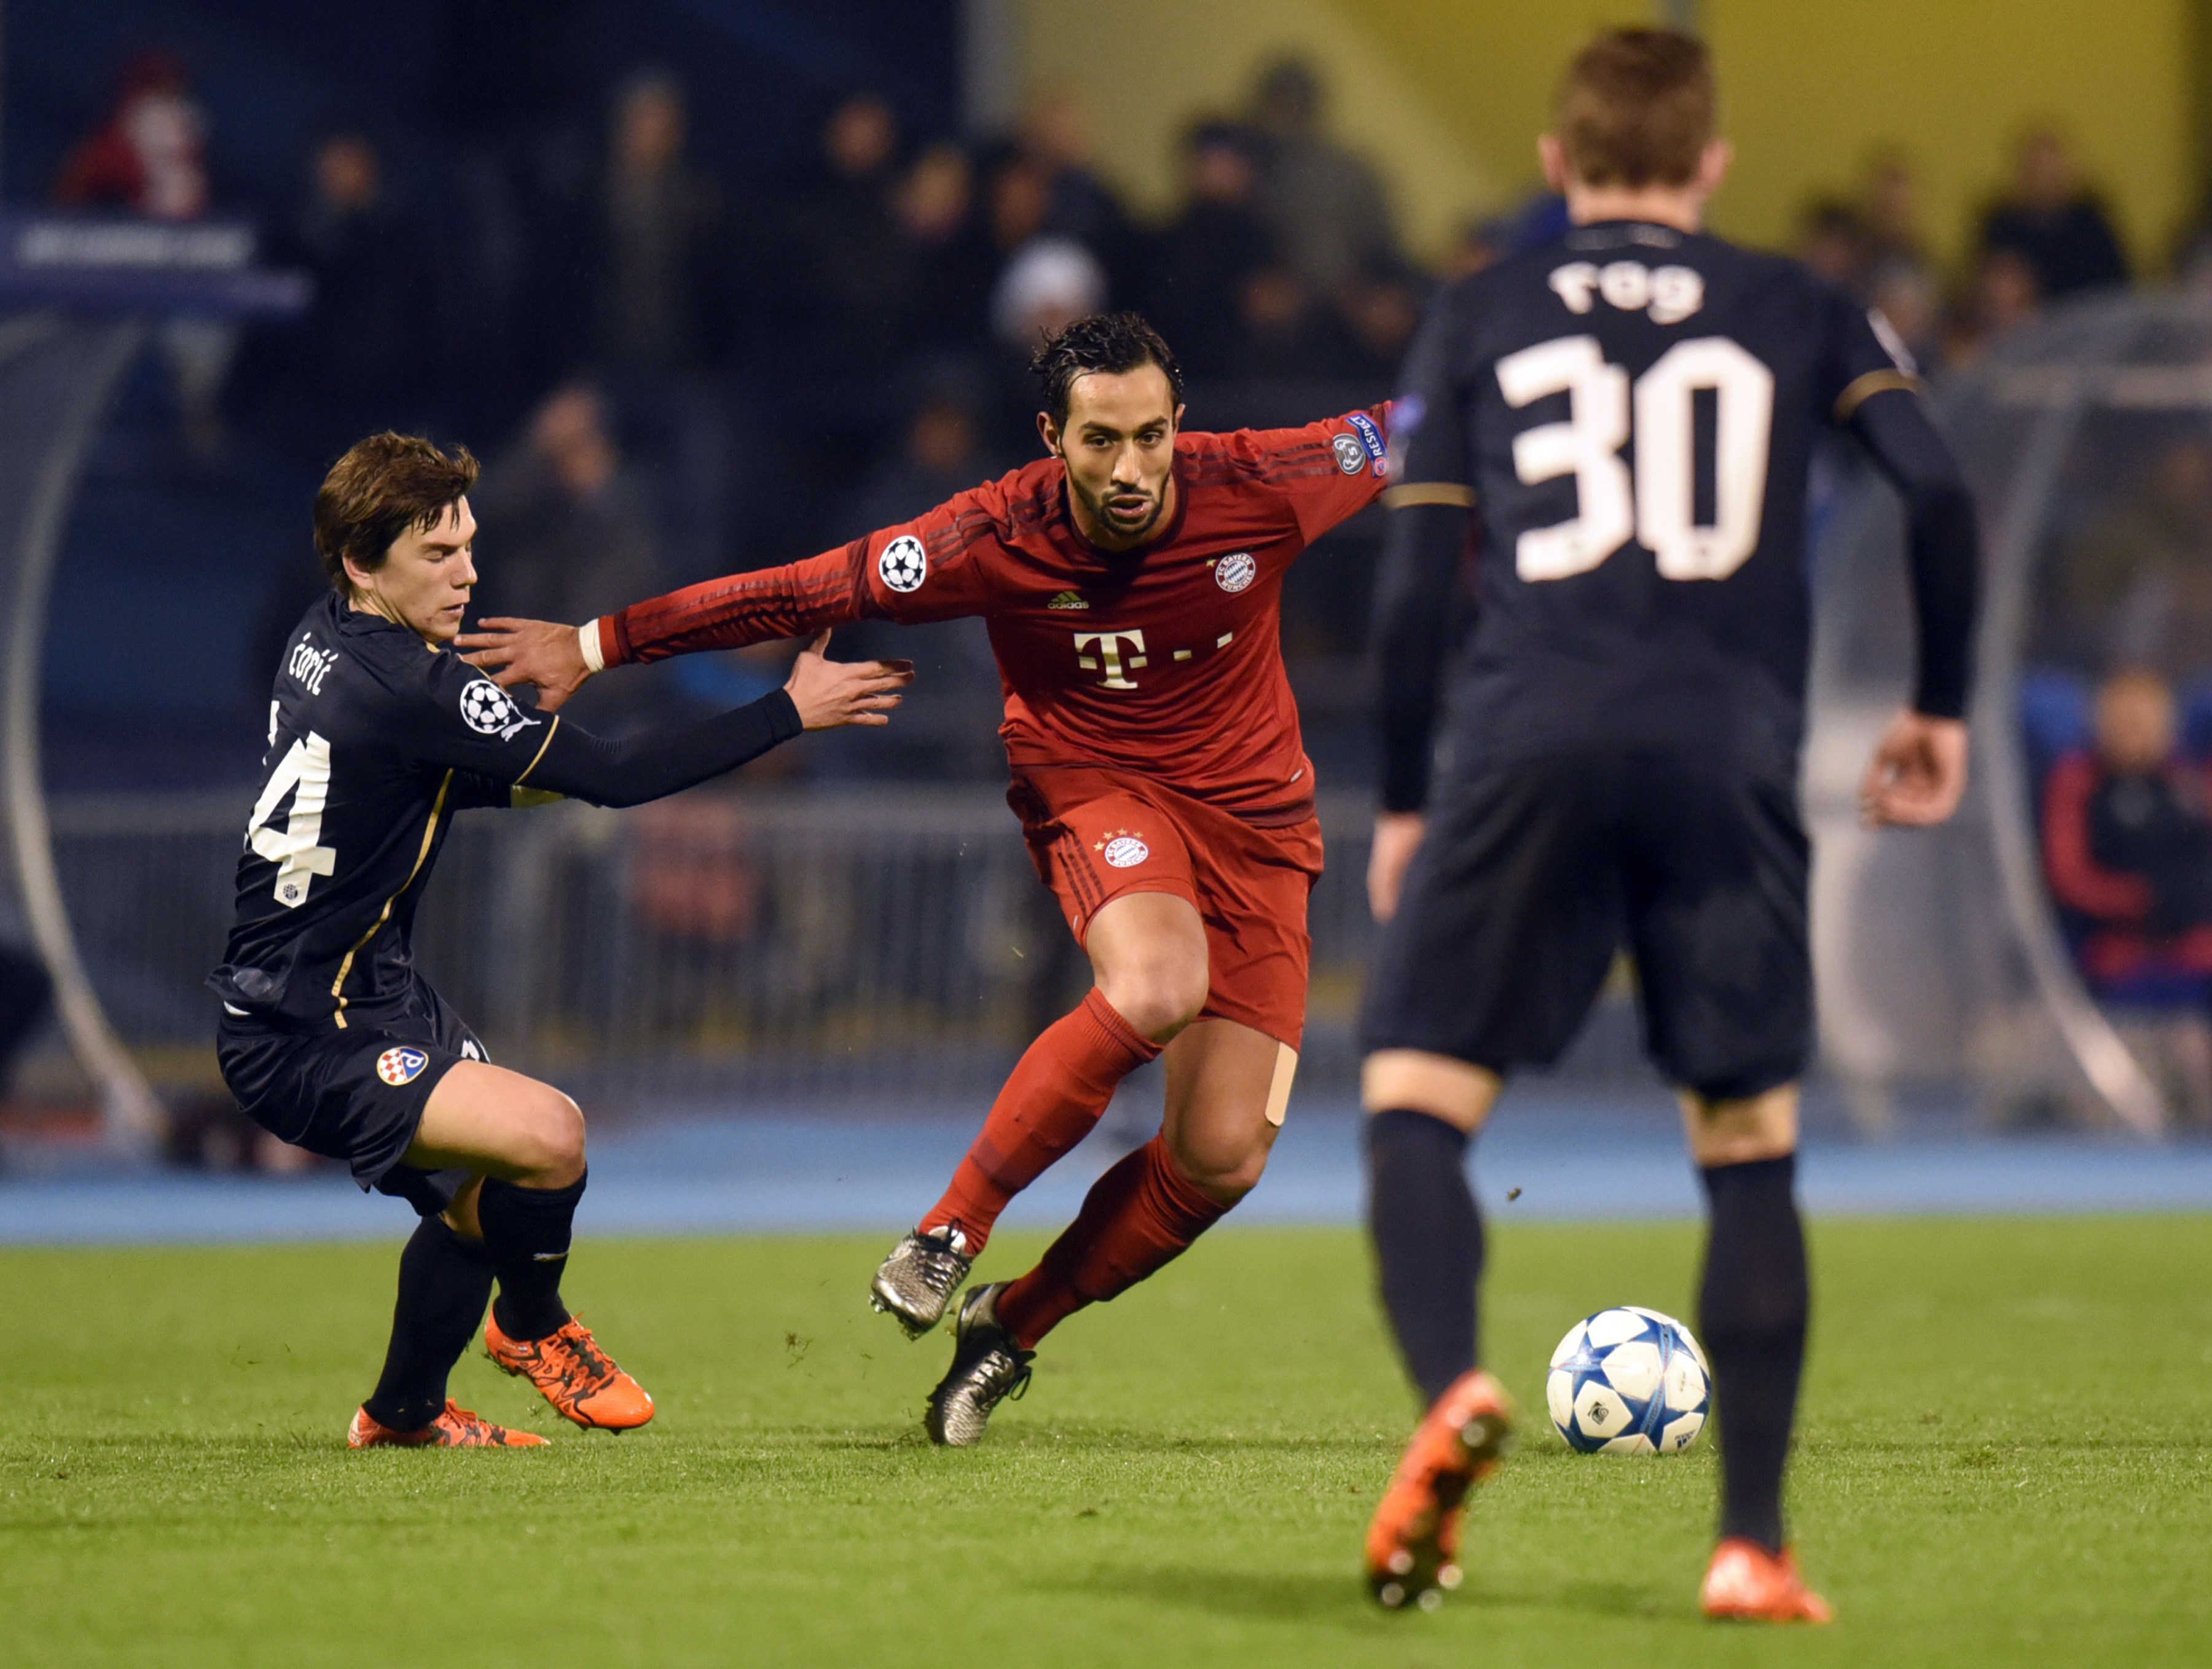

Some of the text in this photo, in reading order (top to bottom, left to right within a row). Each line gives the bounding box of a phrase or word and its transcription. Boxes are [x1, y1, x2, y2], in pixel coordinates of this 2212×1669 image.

[1351, 416, 1382, 456] RESPECT
[1495, 334, 1775, 582] 30
[1223, 554, 1252, 566] BAYERN
[243, 700, 337, 909] 4
